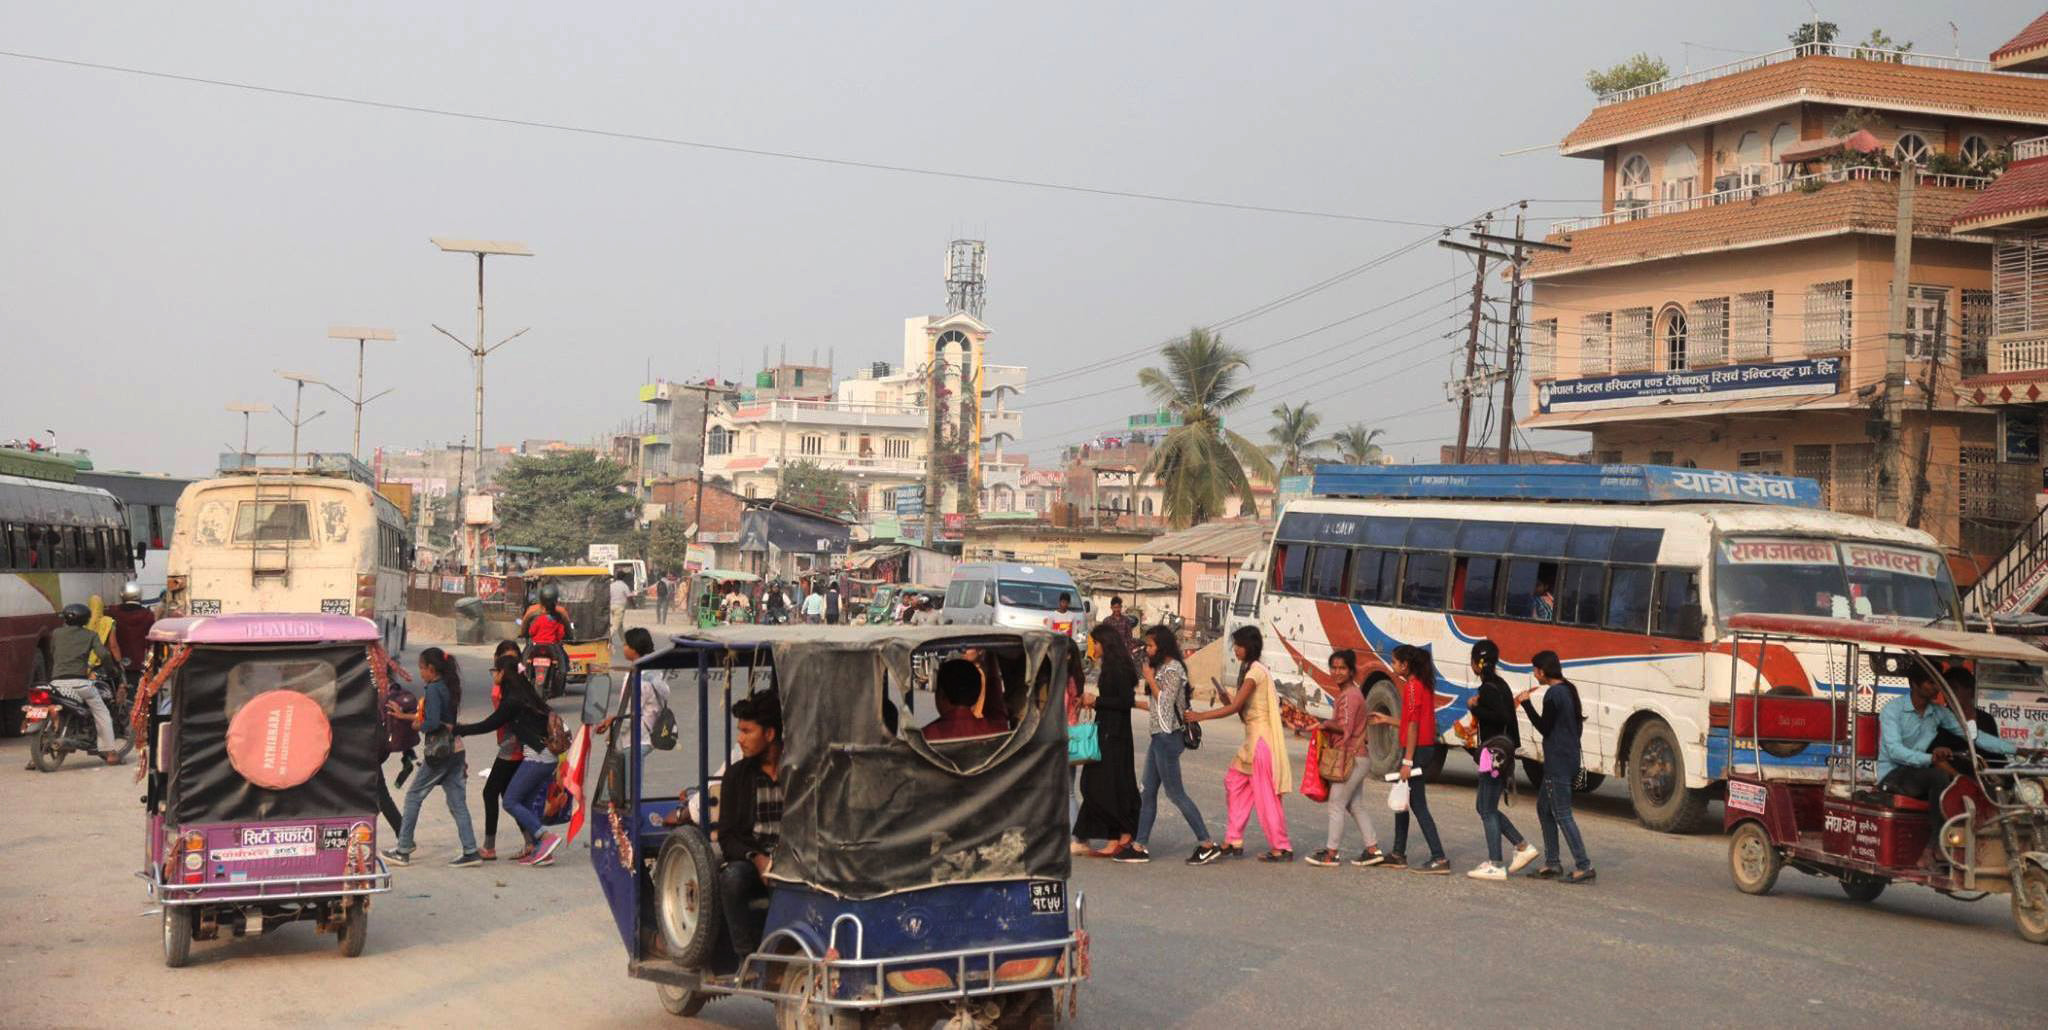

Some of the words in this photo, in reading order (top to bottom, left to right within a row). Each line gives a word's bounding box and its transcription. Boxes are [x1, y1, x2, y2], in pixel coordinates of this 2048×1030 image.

[1550, 382, 1573, 395] नेपाल
[1672, 470, 1739, 495] यात्री
[1739, 473, 1796, 500] सेवा
[1989, 702, 2021, 721] मिठाई
[243, 829, 270, 846] सिटी
[273, 826, 313, 844] सफारी
